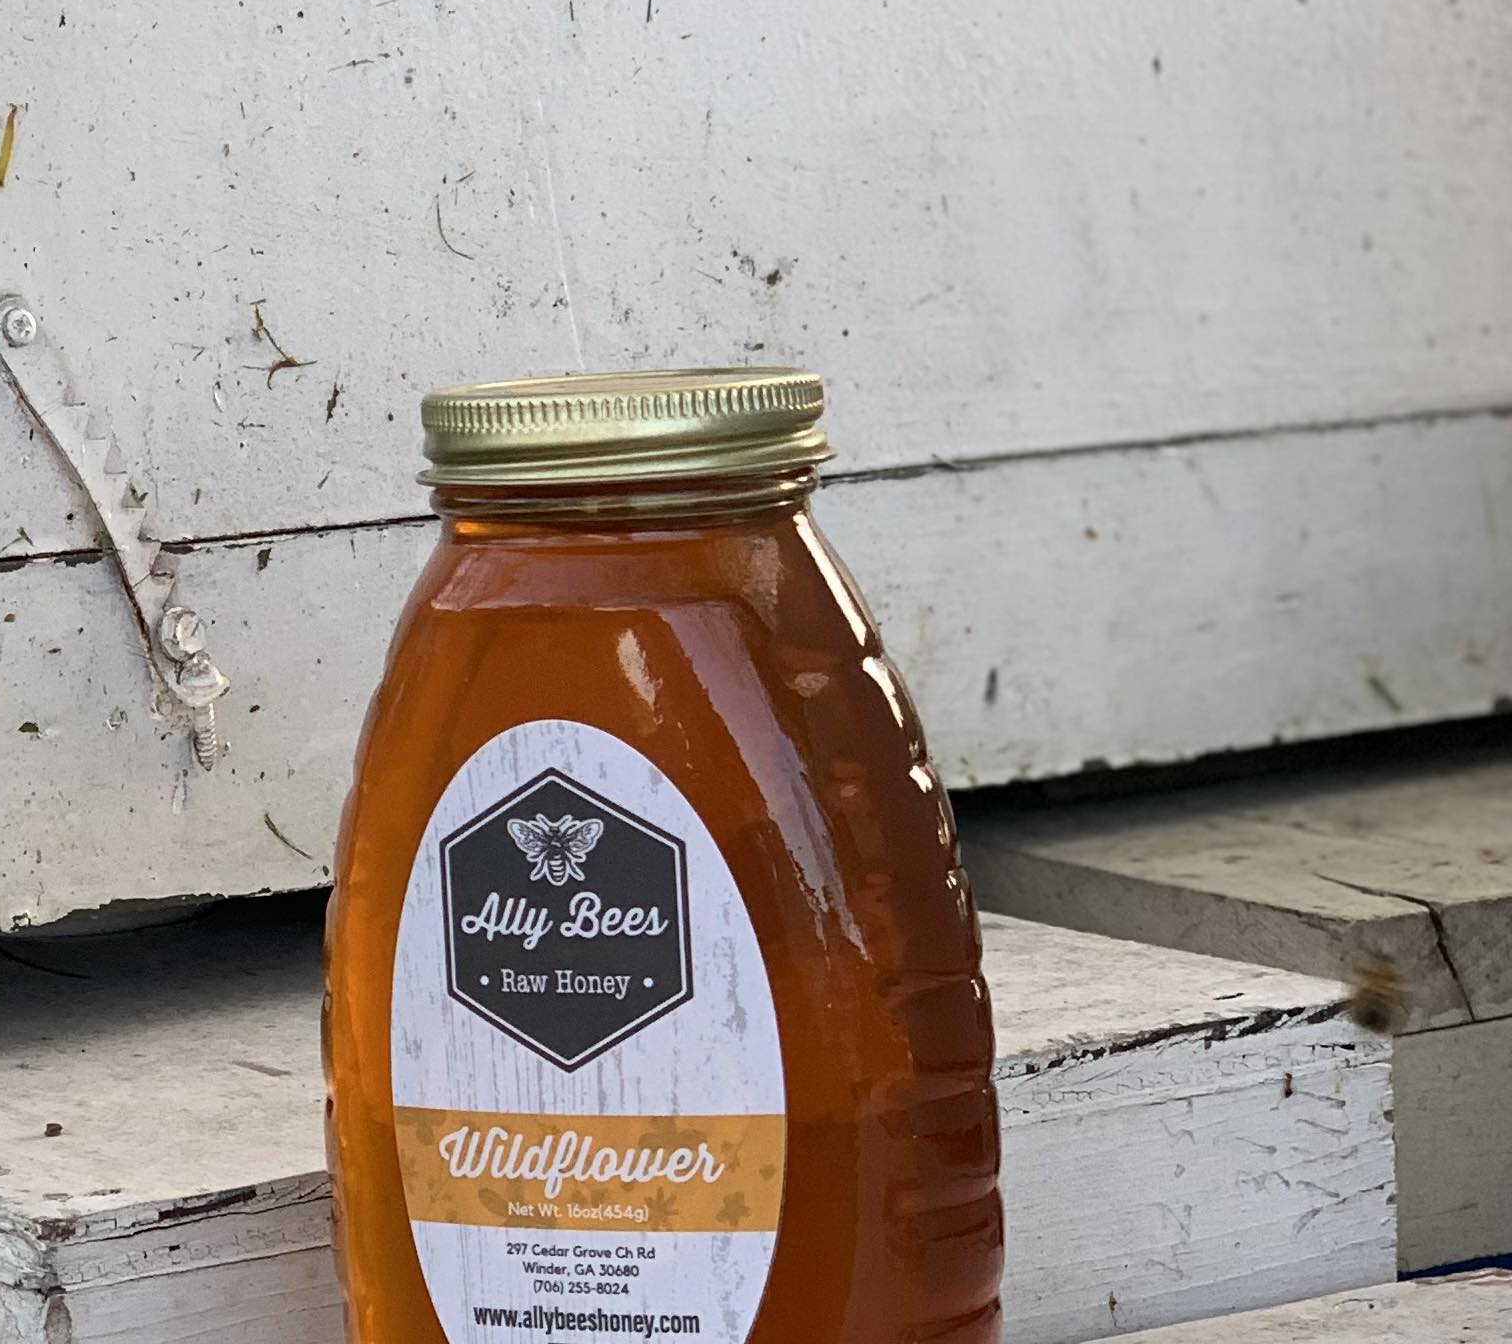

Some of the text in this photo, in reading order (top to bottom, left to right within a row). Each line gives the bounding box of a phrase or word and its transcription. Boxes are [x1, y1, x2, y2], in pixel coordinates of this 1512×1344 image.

[461, 891, 668, 950] Ally Bees
[501, 968, 632, 1000] Raw Honey
[439, 1125, 726, 1199] Wildflower
[508, 1202, 534, 1217] Net
[538, 1203, 562, 1217] Wt.
[506, 1242, 656, 1260] 297 Cedar Grove Ch Rd
[523, 1261, 639, 1277] Winder, GA 30680
[533, 1280, 629, 1295] (706) 255-8024
[473, 1305, 700, 1338] www.allybeeshoney.com
